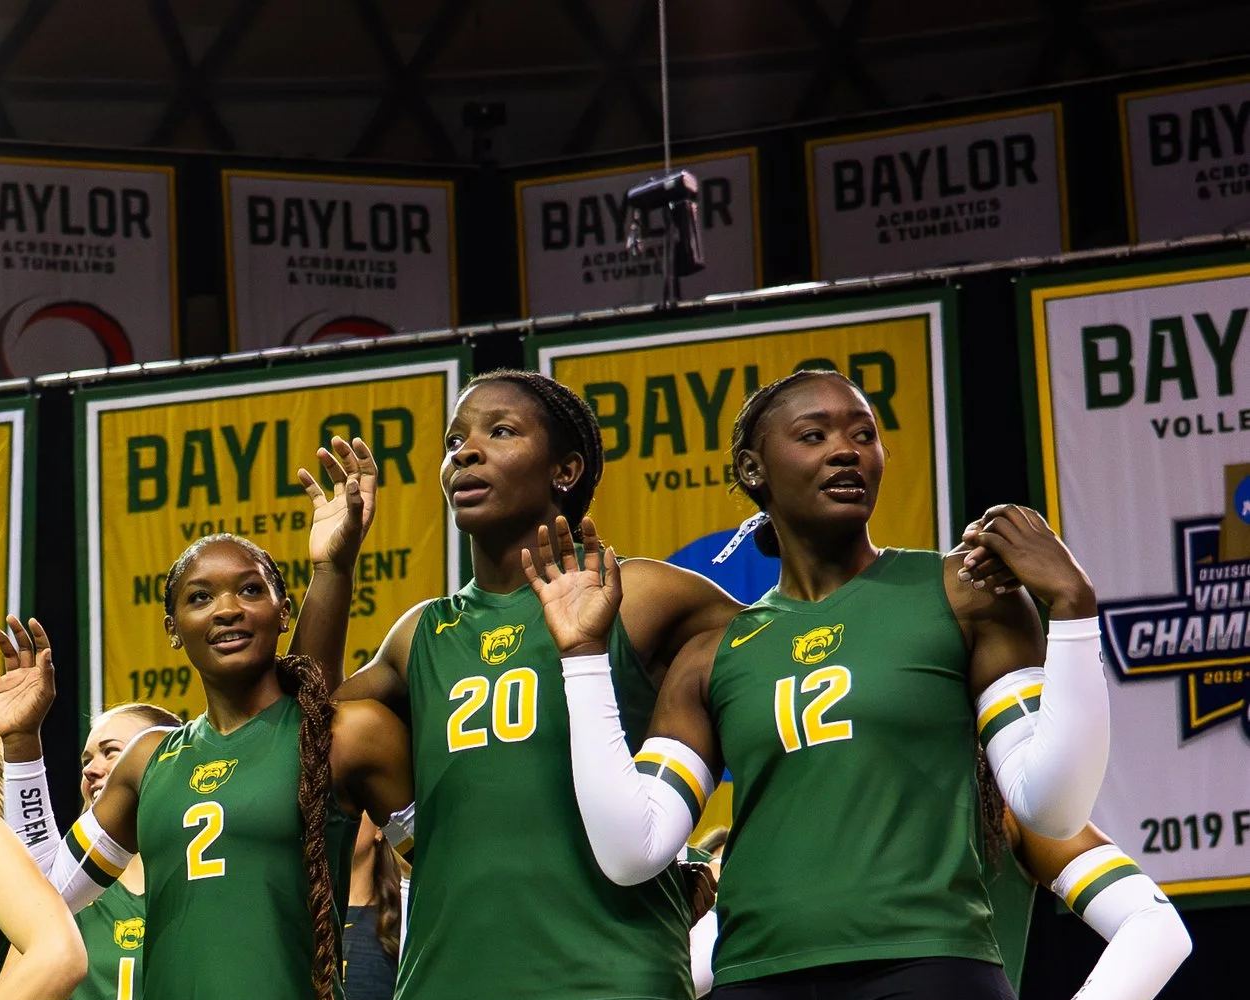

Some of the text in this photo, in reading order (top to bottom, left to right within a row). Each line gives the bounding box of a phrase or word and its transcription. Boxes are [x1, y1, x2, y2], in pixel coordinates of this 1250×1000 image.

[834, 133, 1038, 211] BAYLOR
[248, 195, 432, 254] BAYLOR
[876, 198, 1000, 228] ACROBATICS
[898, 214, 1000, 241] TUMBLING
[2, 239, 116, 259] ACROBATICS
[21, 256, 116, 274] TUMBLING
[286, 256, 397, 275] ACROBATICS
[306, 273, 396, 290] TUMBLING
[584, 350, 900, 465] BAYR
[129, 667, 191, 700] 1999
[447, 666, 538, 753] 20
[774, 665, 853, 753] 12
[182, 801, 226, 881] 2
[1140, 812, 1223, 854] 2019
